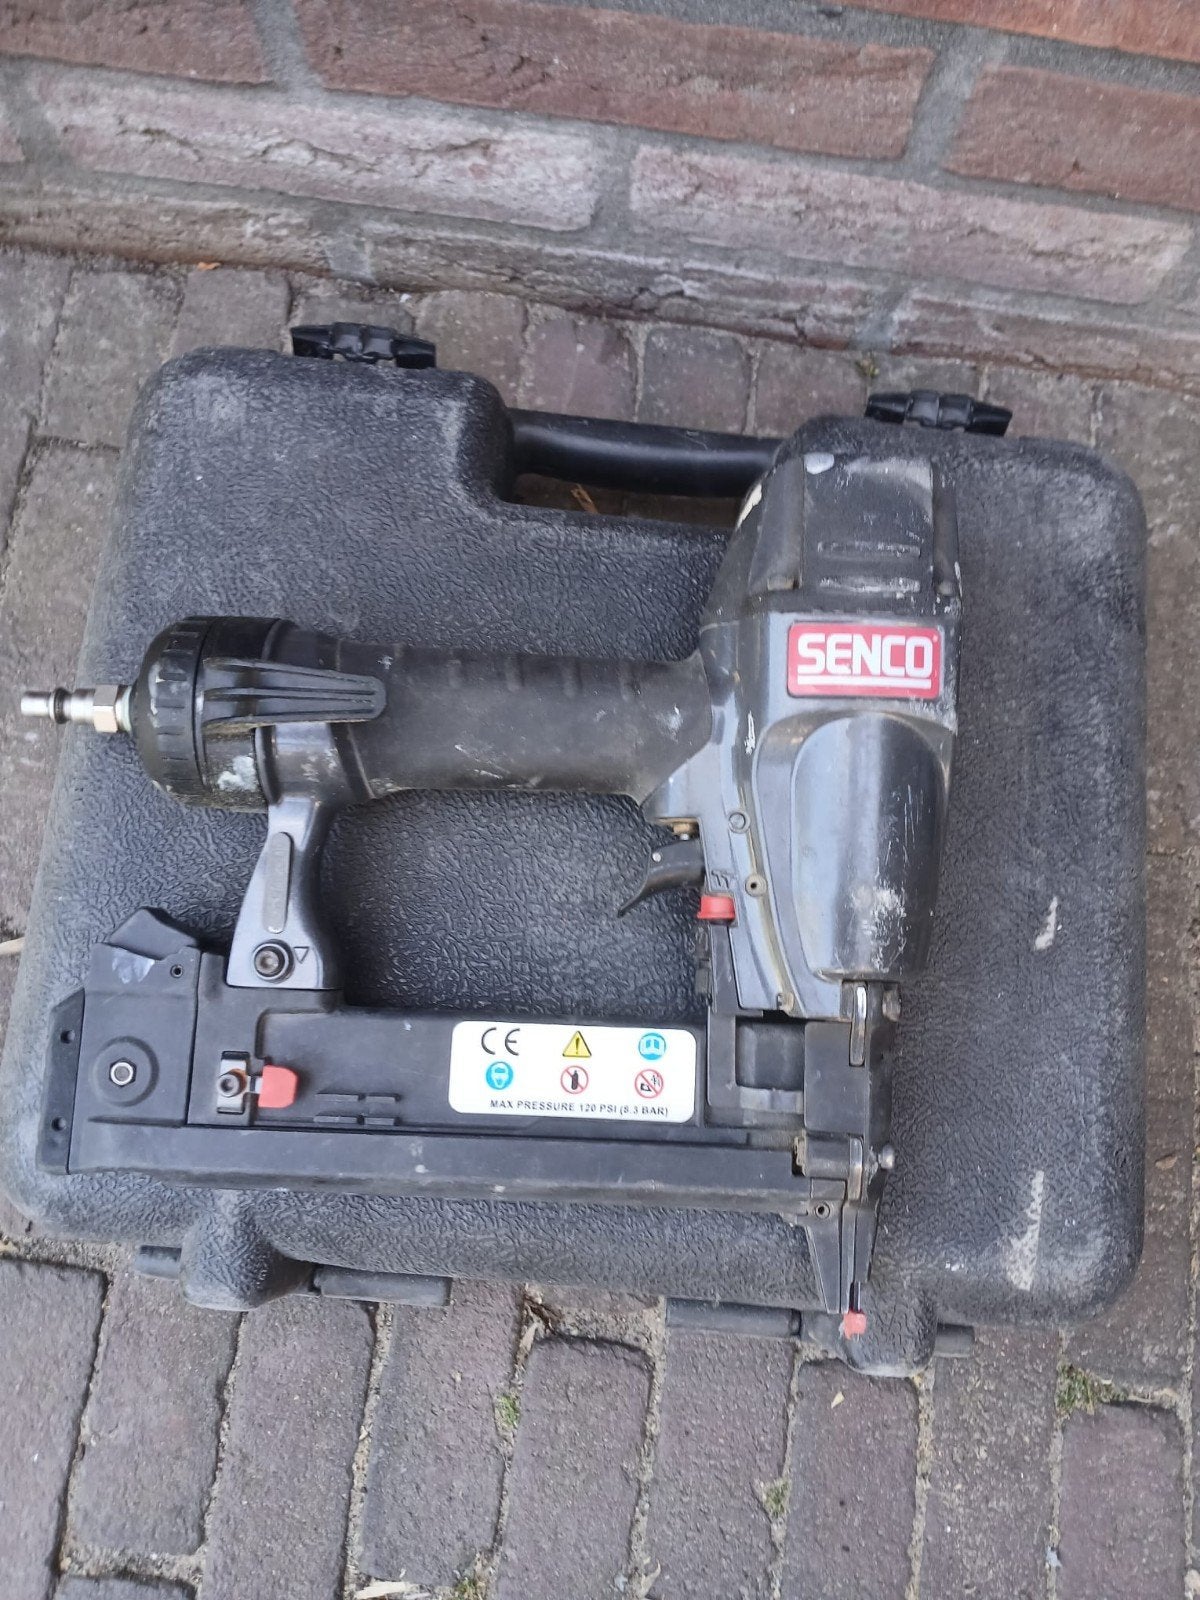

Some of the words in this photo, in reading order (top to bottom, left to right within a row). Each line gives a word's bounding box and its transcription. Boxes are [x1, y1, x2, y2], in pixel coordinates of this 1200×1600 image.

[797, 633, 933, 678] SENCO
[481, 1027, 520, 1056] CE
[490, 1099, 513, 1109] MAX
[517, 1100, 575, 1112] PRESSURE
[580, 1103, 597, 1112] 120
[600, 1104, 617, 1113] PSI
[642, 1106, 668, 1117] BAR)
